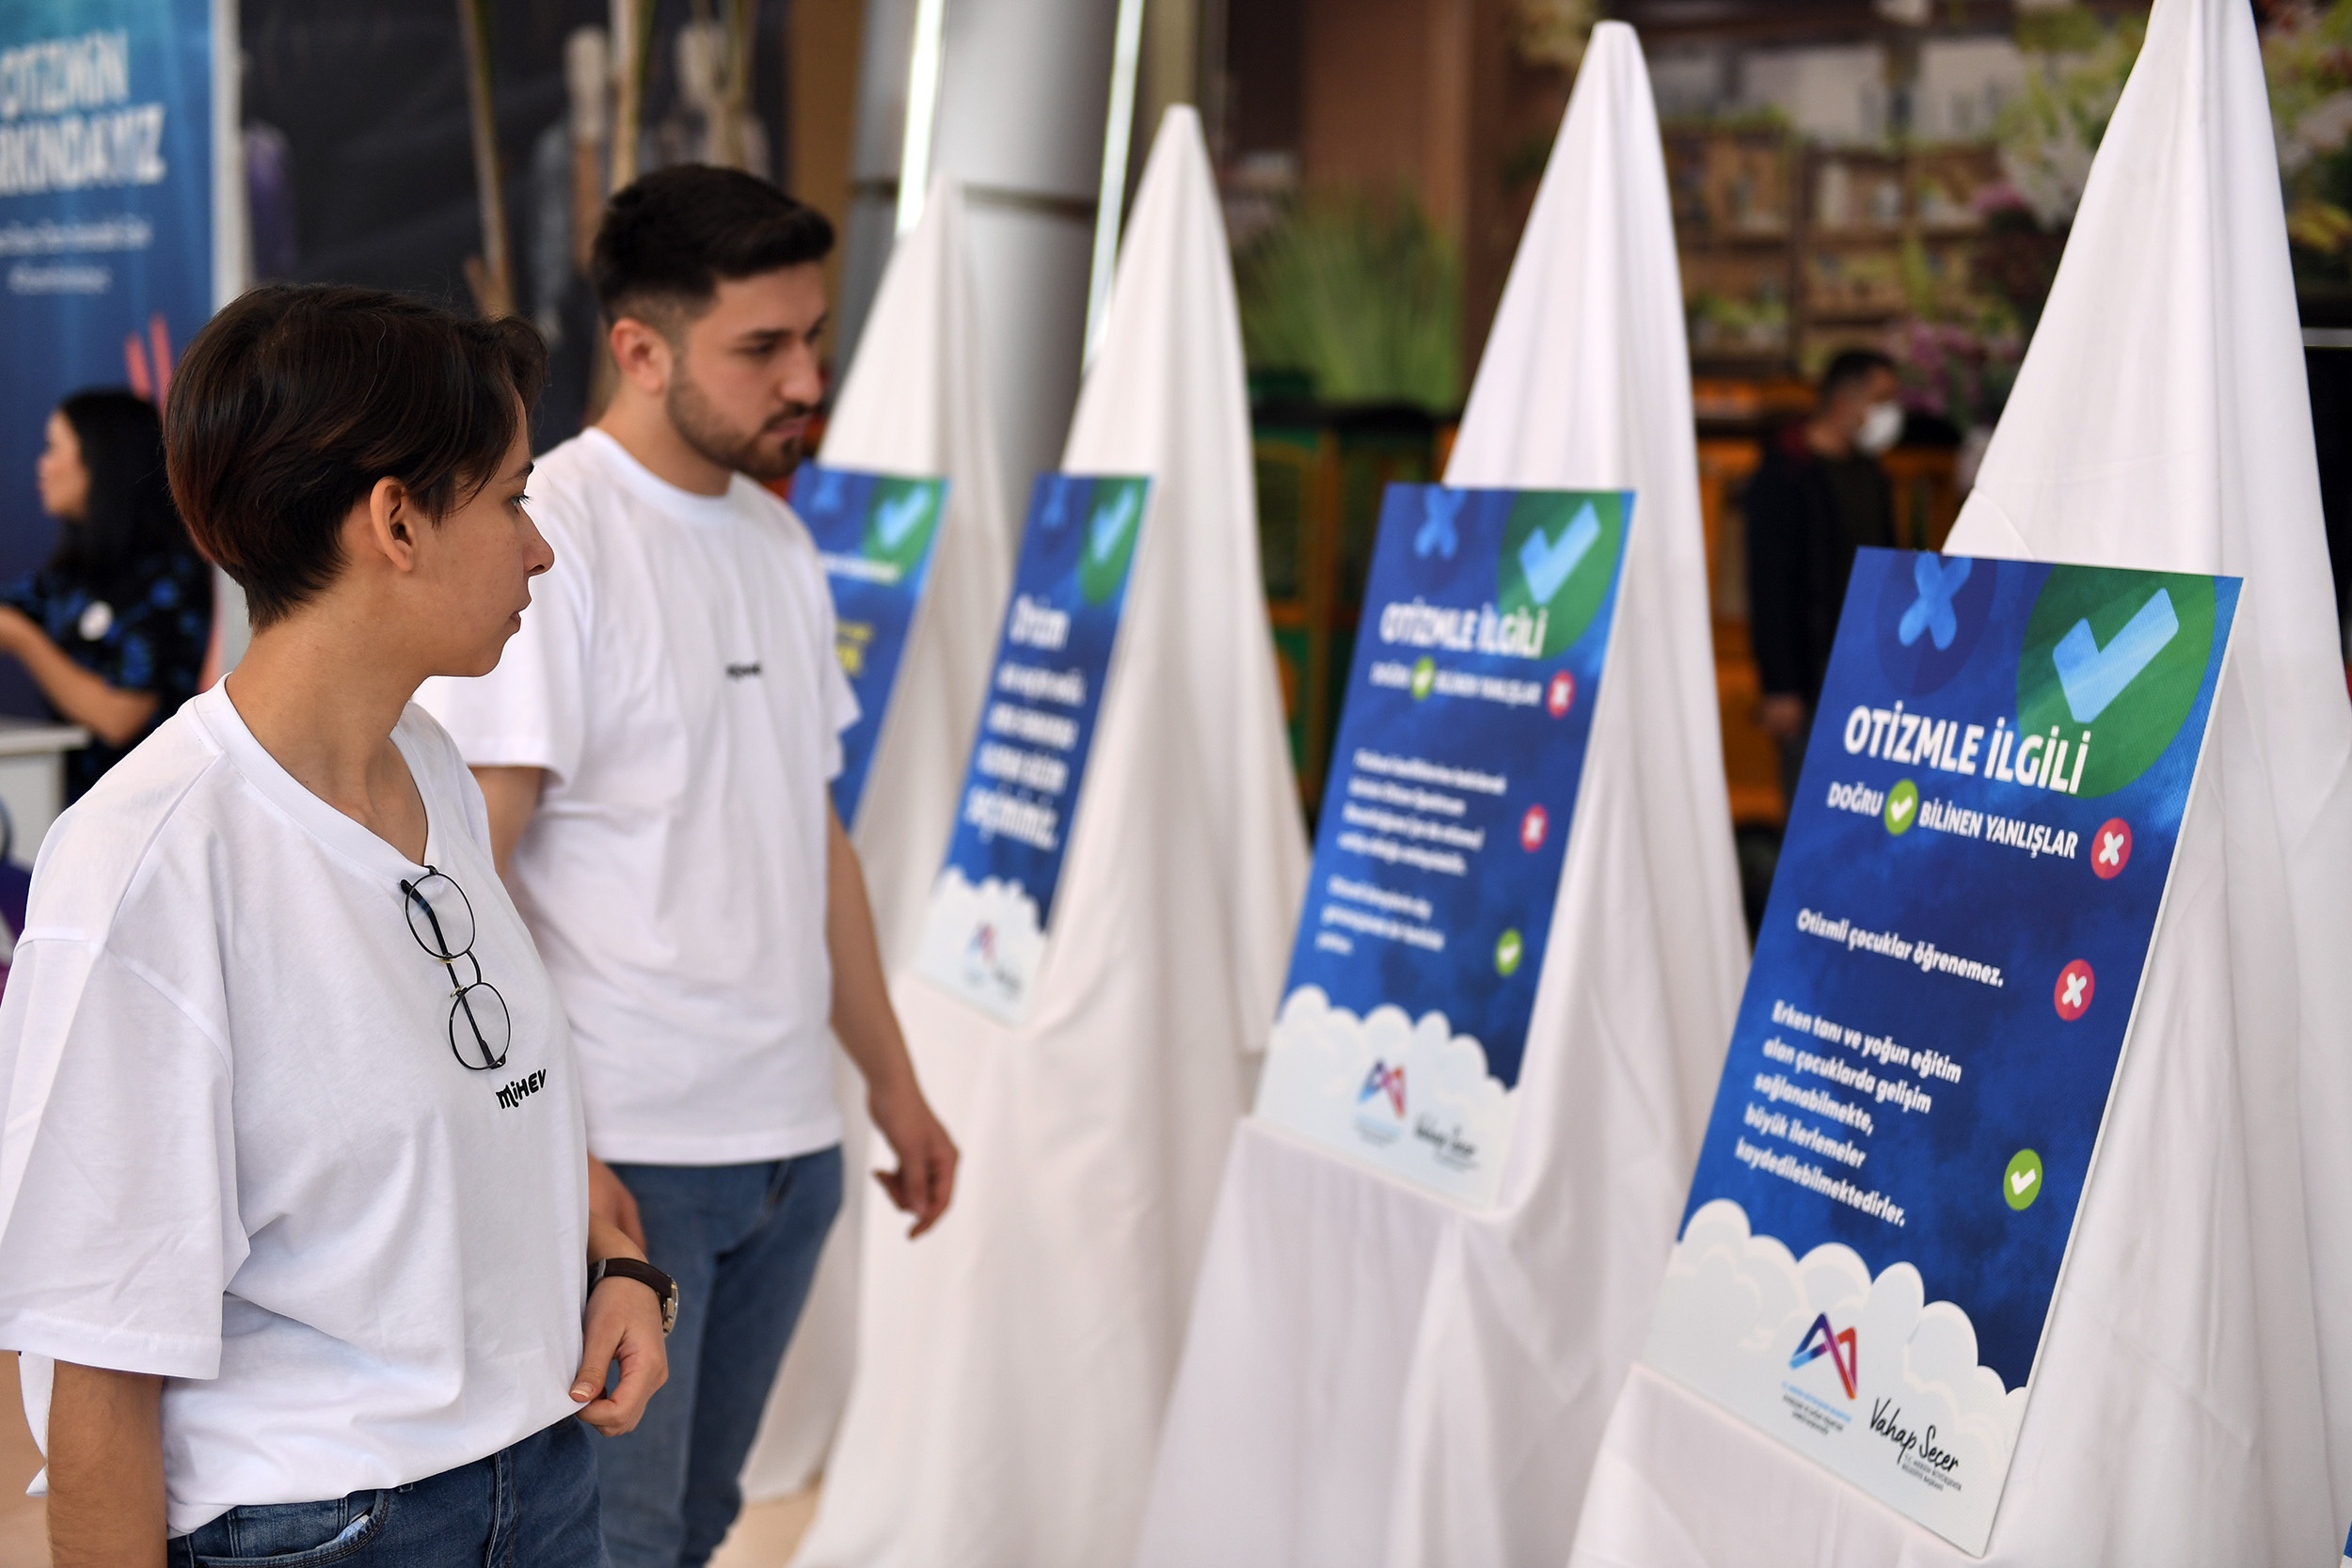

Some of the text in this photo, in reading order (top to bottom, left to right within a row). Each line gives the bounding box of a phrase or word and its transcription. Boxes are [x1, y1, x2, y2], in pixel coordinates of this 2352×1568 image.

[1844, 701, 2091, 795] OTİZMLE İLGİLİ
[1827, 782, 2078, 859] DOĞRU BİLİNEN YANLIŞLAR
[1796, 908, 2003, 988] Otizmli çocuklar öğrenemez.
[1763, 1037, 1931, 1114] alan çocuklarda gelişim
[1772, 999, 1962, 1084] Erken tanı ve yoğun eğitim
[1744, 1102, 1867, 1169] büyük ilerlemeler
[1754, 1072, 1874, 1136] sağlanabilmekte,
[1734, 1136, 1905, 1227] kaydedilebilmektedirler.
[1869, 1397, 1917, 1465] Vahap
[1919, 1424, 1959, 1472] Seçer
